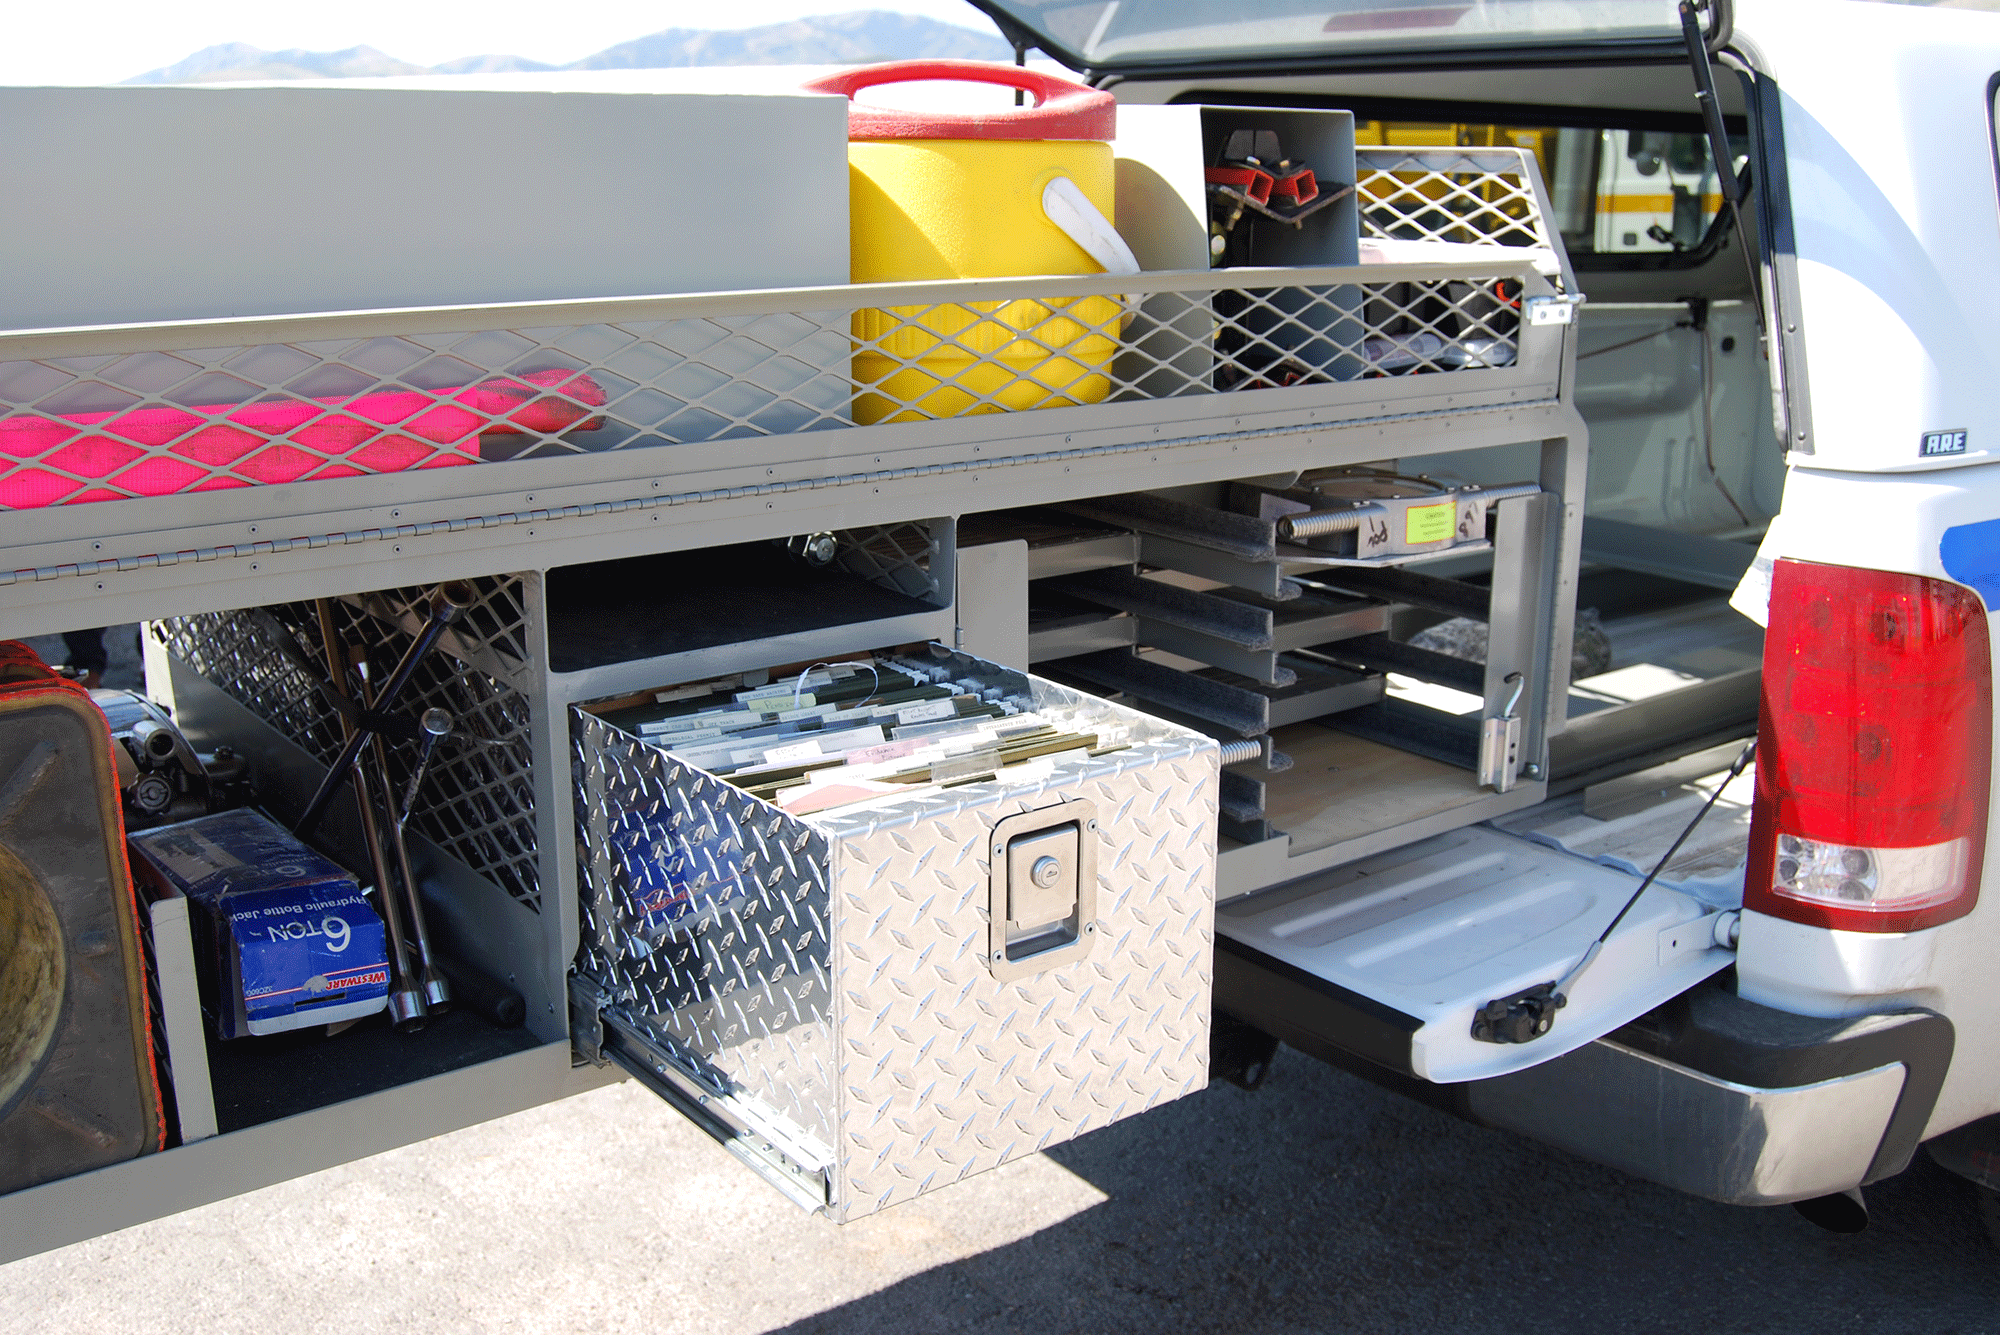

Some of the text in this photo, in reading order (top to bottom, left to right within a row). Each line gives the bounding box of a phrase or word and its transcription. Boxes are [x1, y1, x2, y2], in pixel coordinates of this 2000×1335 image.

[263, 904, 303, 917] Bottle
[305, 895, 368, 911] Hydraulic
[267, 916, 351, 953] 6 TON
